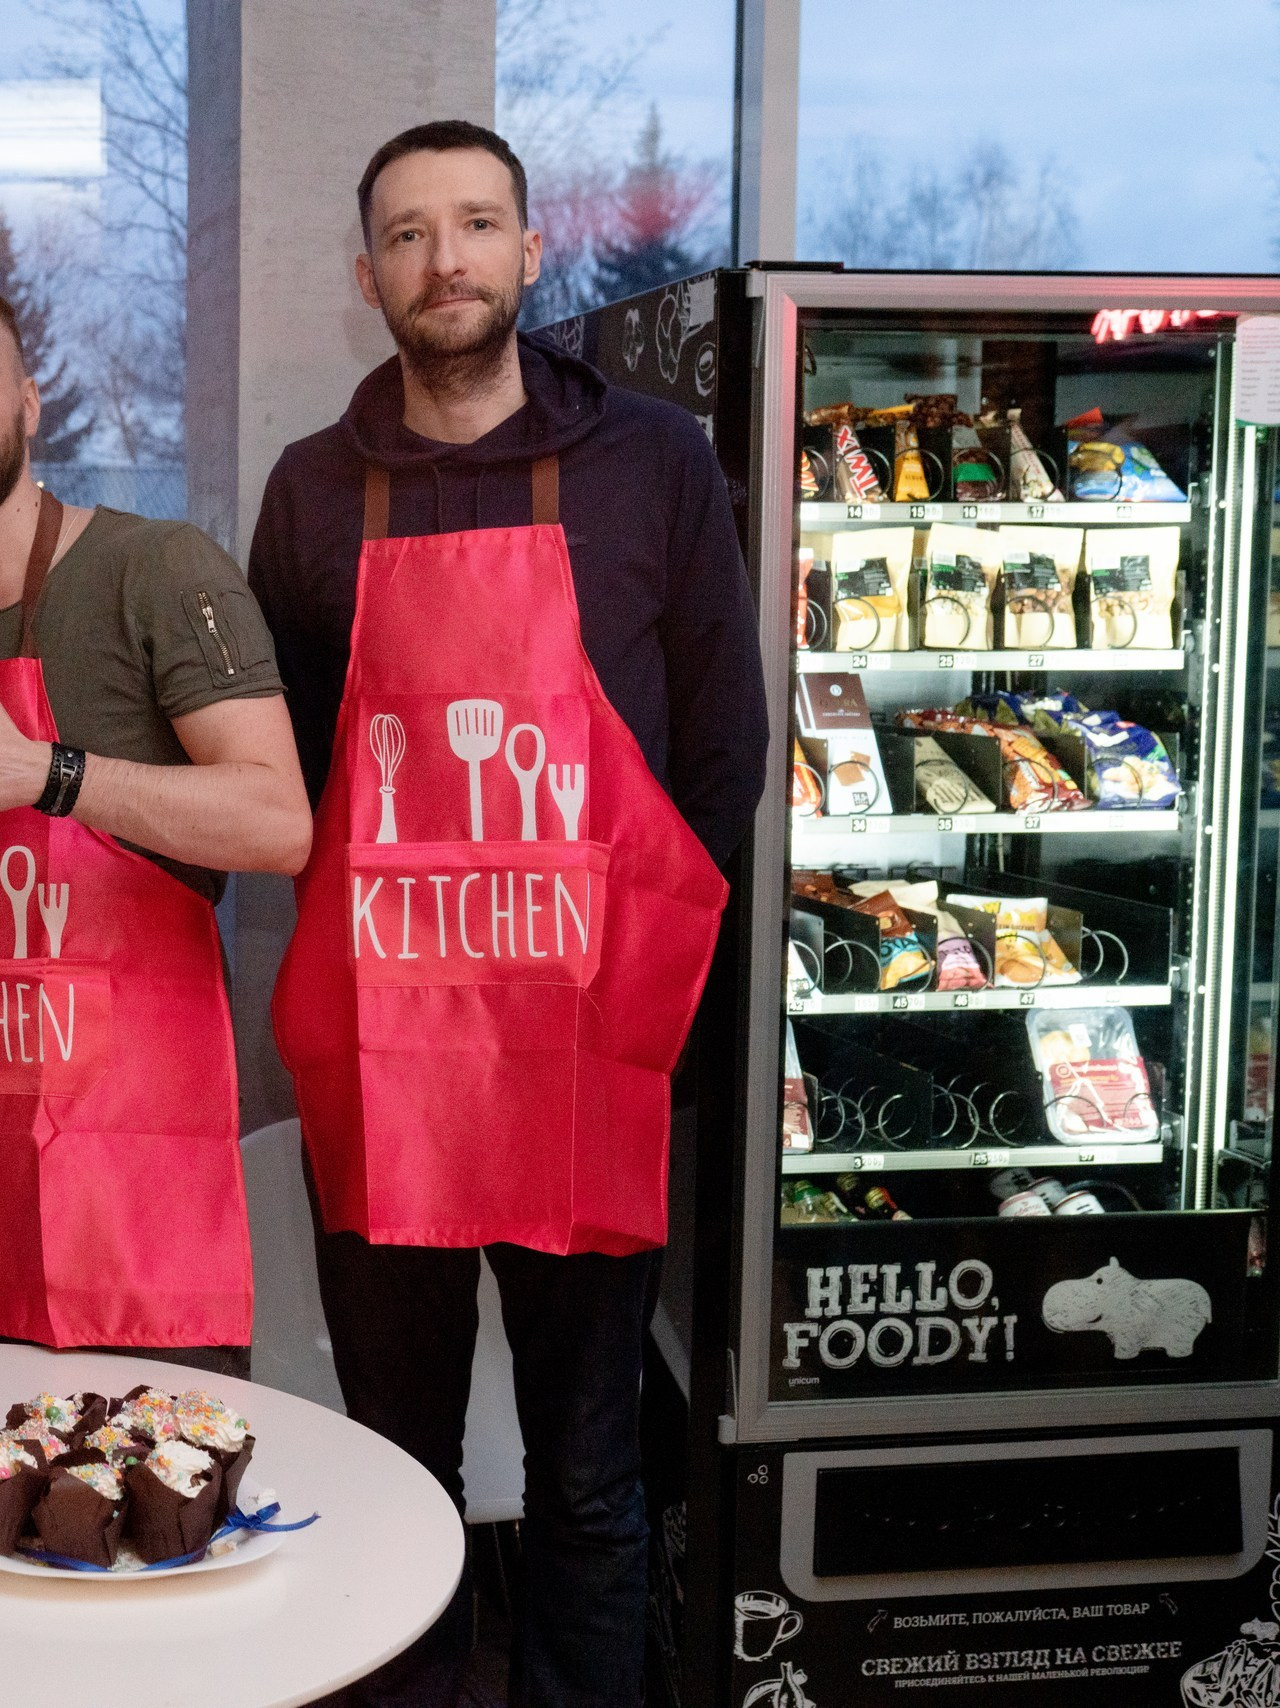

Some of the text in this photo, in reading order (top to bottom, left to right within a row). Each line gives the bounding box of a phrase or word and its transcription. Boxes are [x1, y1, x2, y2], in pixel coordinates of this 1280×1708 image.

[835, 425, 880, 499] TWIX
[848, 506, 862, 518] 14
[911, 506, 925, 518] 15
[853, 655, 867, 668] 24
[939, 655, 954, 668] 25
[1029, 655, 1044, 667] 27
[853, 819, 867, 831] 34
[938, 818, 953, 830] 35
[1025, 816, 1040, 829] 37
[353, 871, 590, 959] KITCHEN
[895, 996, 909, 1008] 45
[1021, 992, 1035, 1005] 47
[805, 1259, 999, 1318] HELLO,
[782, 1315, 1018, 1369] FOODY!
[788, 1376, 820, 1386] unicum
[893, 1602, 1150, 1629] ВОЗЬМИТЕ, ПОЖАЛУЙСТА, ВАШ ТОВАР
[861, 1641, 1183, 1676] СВЕЖИЙ ВЗГЛЯД НА СВЕЖЕЕ
[894, 1674, 987, 1689] ПРИСОЕДИНЯЙТЕСЬ
[987, 1674, 995, 1683] К
[996, 1671, 1030, 1682] НАШЕЙ
[1032, 1667, 1089, 1681] МАЛЕНЬКОЙ
